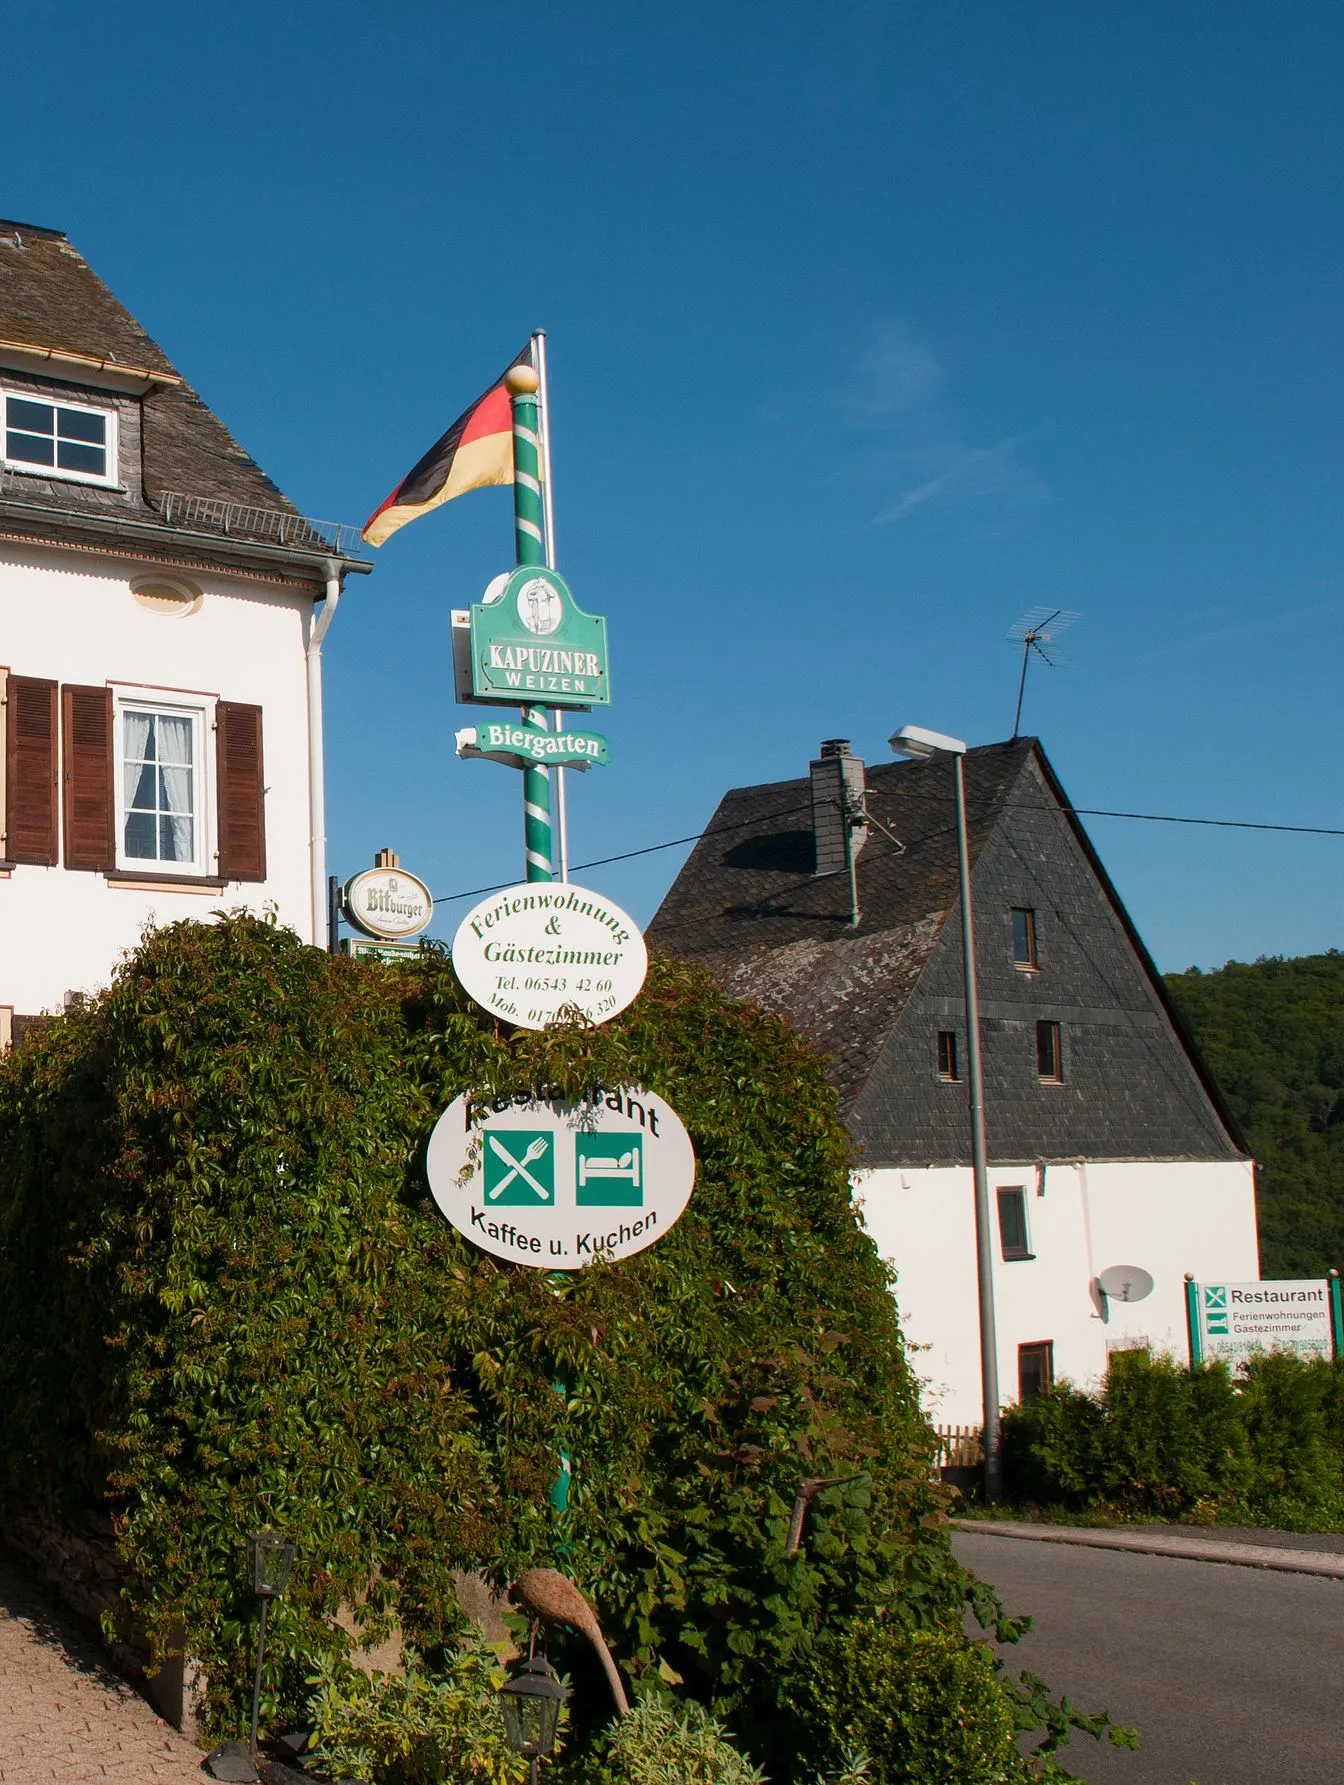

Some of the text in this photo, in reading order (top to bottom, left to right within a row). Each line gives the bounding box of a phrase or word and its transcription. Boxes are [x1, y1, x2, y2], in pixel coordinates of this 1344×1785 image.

[489, 645, 600, 677] KAPUZINER
[505, 672, 585, 692] WEIZEN
[488, 725, 600, 758] Biergarten
[366, 888, 423, 918] Bitburger
[469, 892, 630, 945] Ferienwohnung
[544, 915, 562, 935] &
[484, 942, 624, 966] Gästezimmer
[496, 976, 612, 992] Tel. 06543 42 60
[488, 992, 519, 1017] Mob.
[597, 994, 616, 1015] 320
[470, 1206, 657, 1256] Kaffee u. Kuchen
[1231, 1289, 1324, 1303] Restaurant
[1233, 1311, 1325, 1321] Ferienwohnungen
